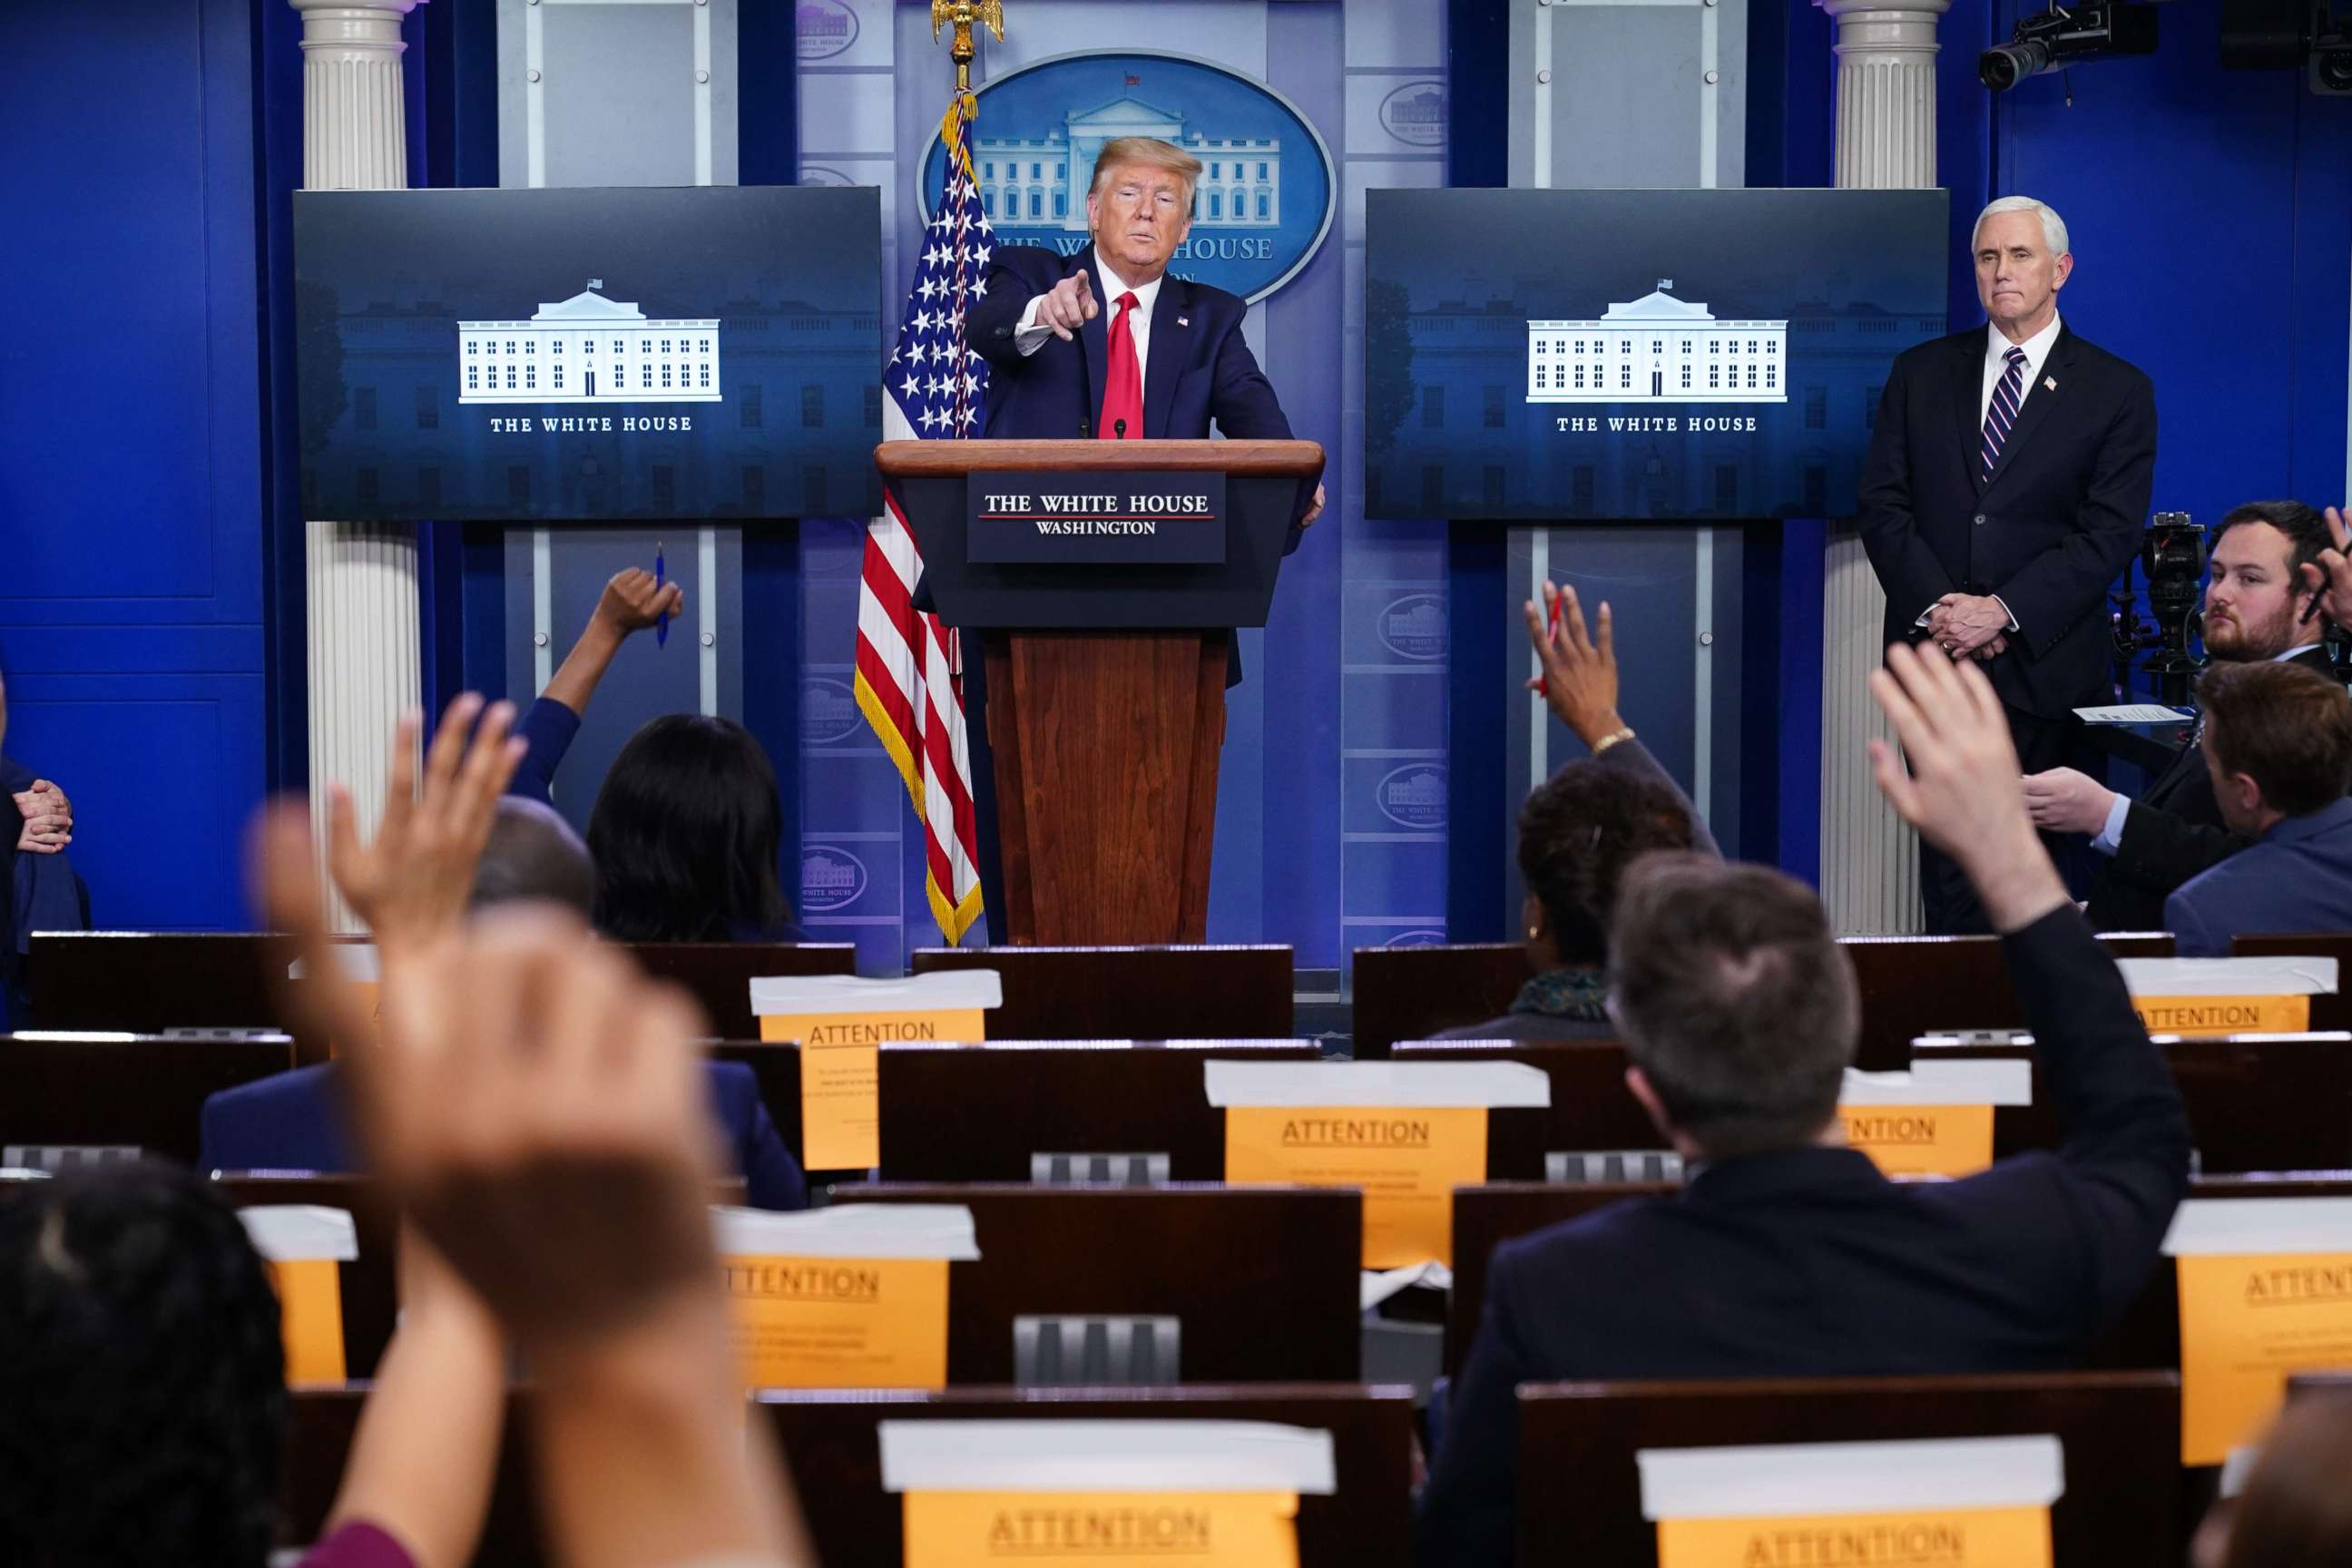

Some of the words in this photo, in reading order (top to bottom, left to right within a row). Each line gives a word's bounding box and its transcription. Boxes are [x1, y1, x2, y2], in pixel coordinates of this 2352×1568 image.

[1171, 237, 1273, 260] HOUSE
[491, 418, 532, 432] THE
[543, 417, 612, 432] WHITE
[622, 416, 691, 431] HOUSE
[1557, 418, 1598, 432] THE
[1608, 418, 1678, 432] WHITE
[1688, 418, 1756, 432] HOUSE
[985, 495, 1032, 512] THE
[1040, 495, 1118, 513] WHITE
[1130, 495, 1209, 513] HOUSE
[1036, 521, 1156, 535] WASHINGTON
[809, 1022, 935, 1044] ATTENTION
[1282, 1119, 1430, 1142] ATTENTION
[722, 1264, 880, 1298] TTENTION
[987, 1507, 1213, 1548] ATTENTION
